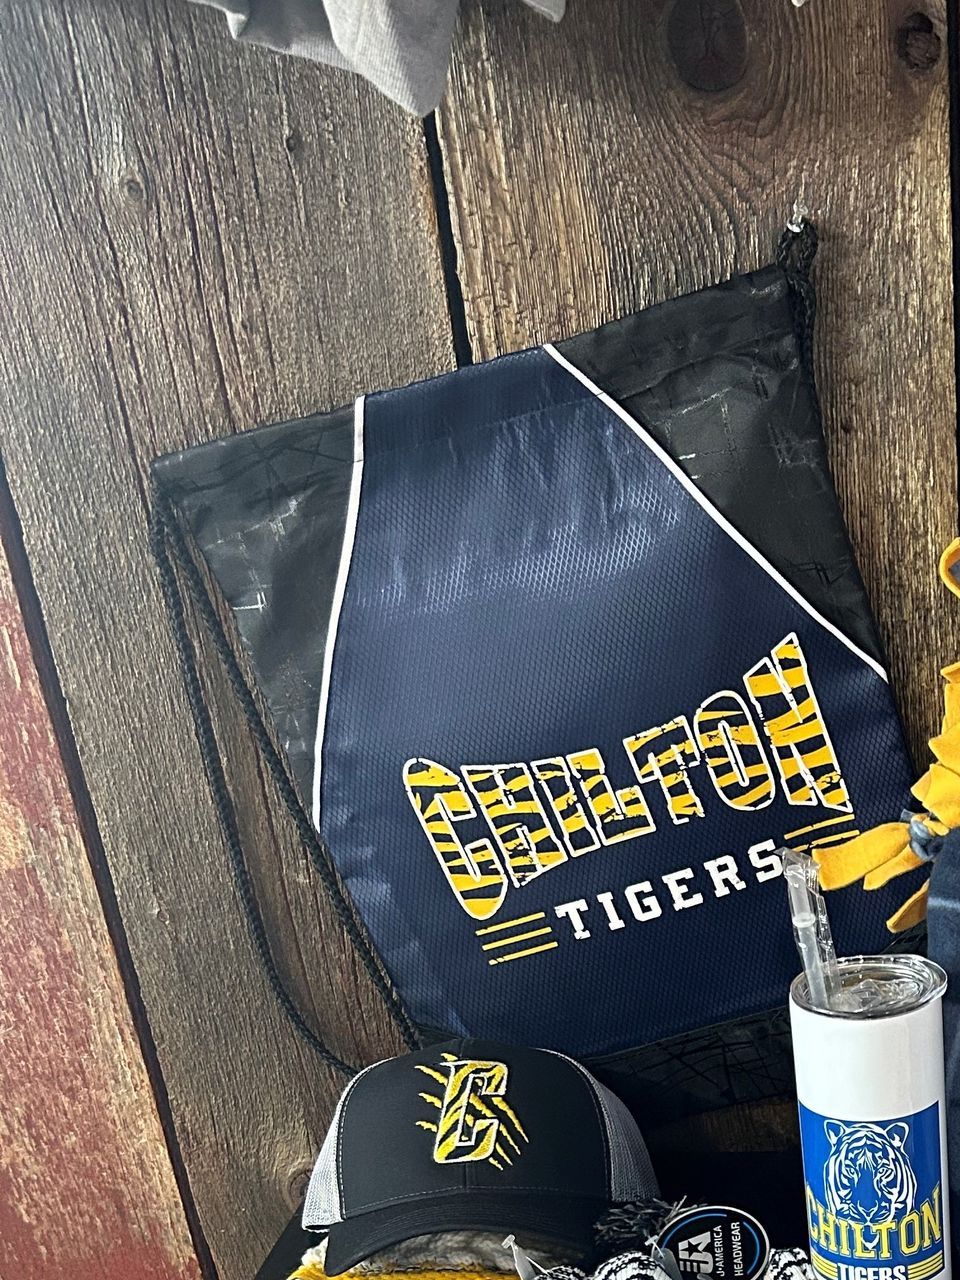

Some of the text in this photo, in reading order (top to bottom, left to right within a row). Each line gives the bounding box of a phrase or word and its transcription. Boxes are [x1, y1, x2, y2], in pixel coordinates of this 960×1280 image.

[403, 632, 854, 920] CHILTON
[555, 838, 785, 940] TIGERS
[731, 1222, 744, 1277] HEADWEAR
[805, 1182, 943, 1260] CHILTON
